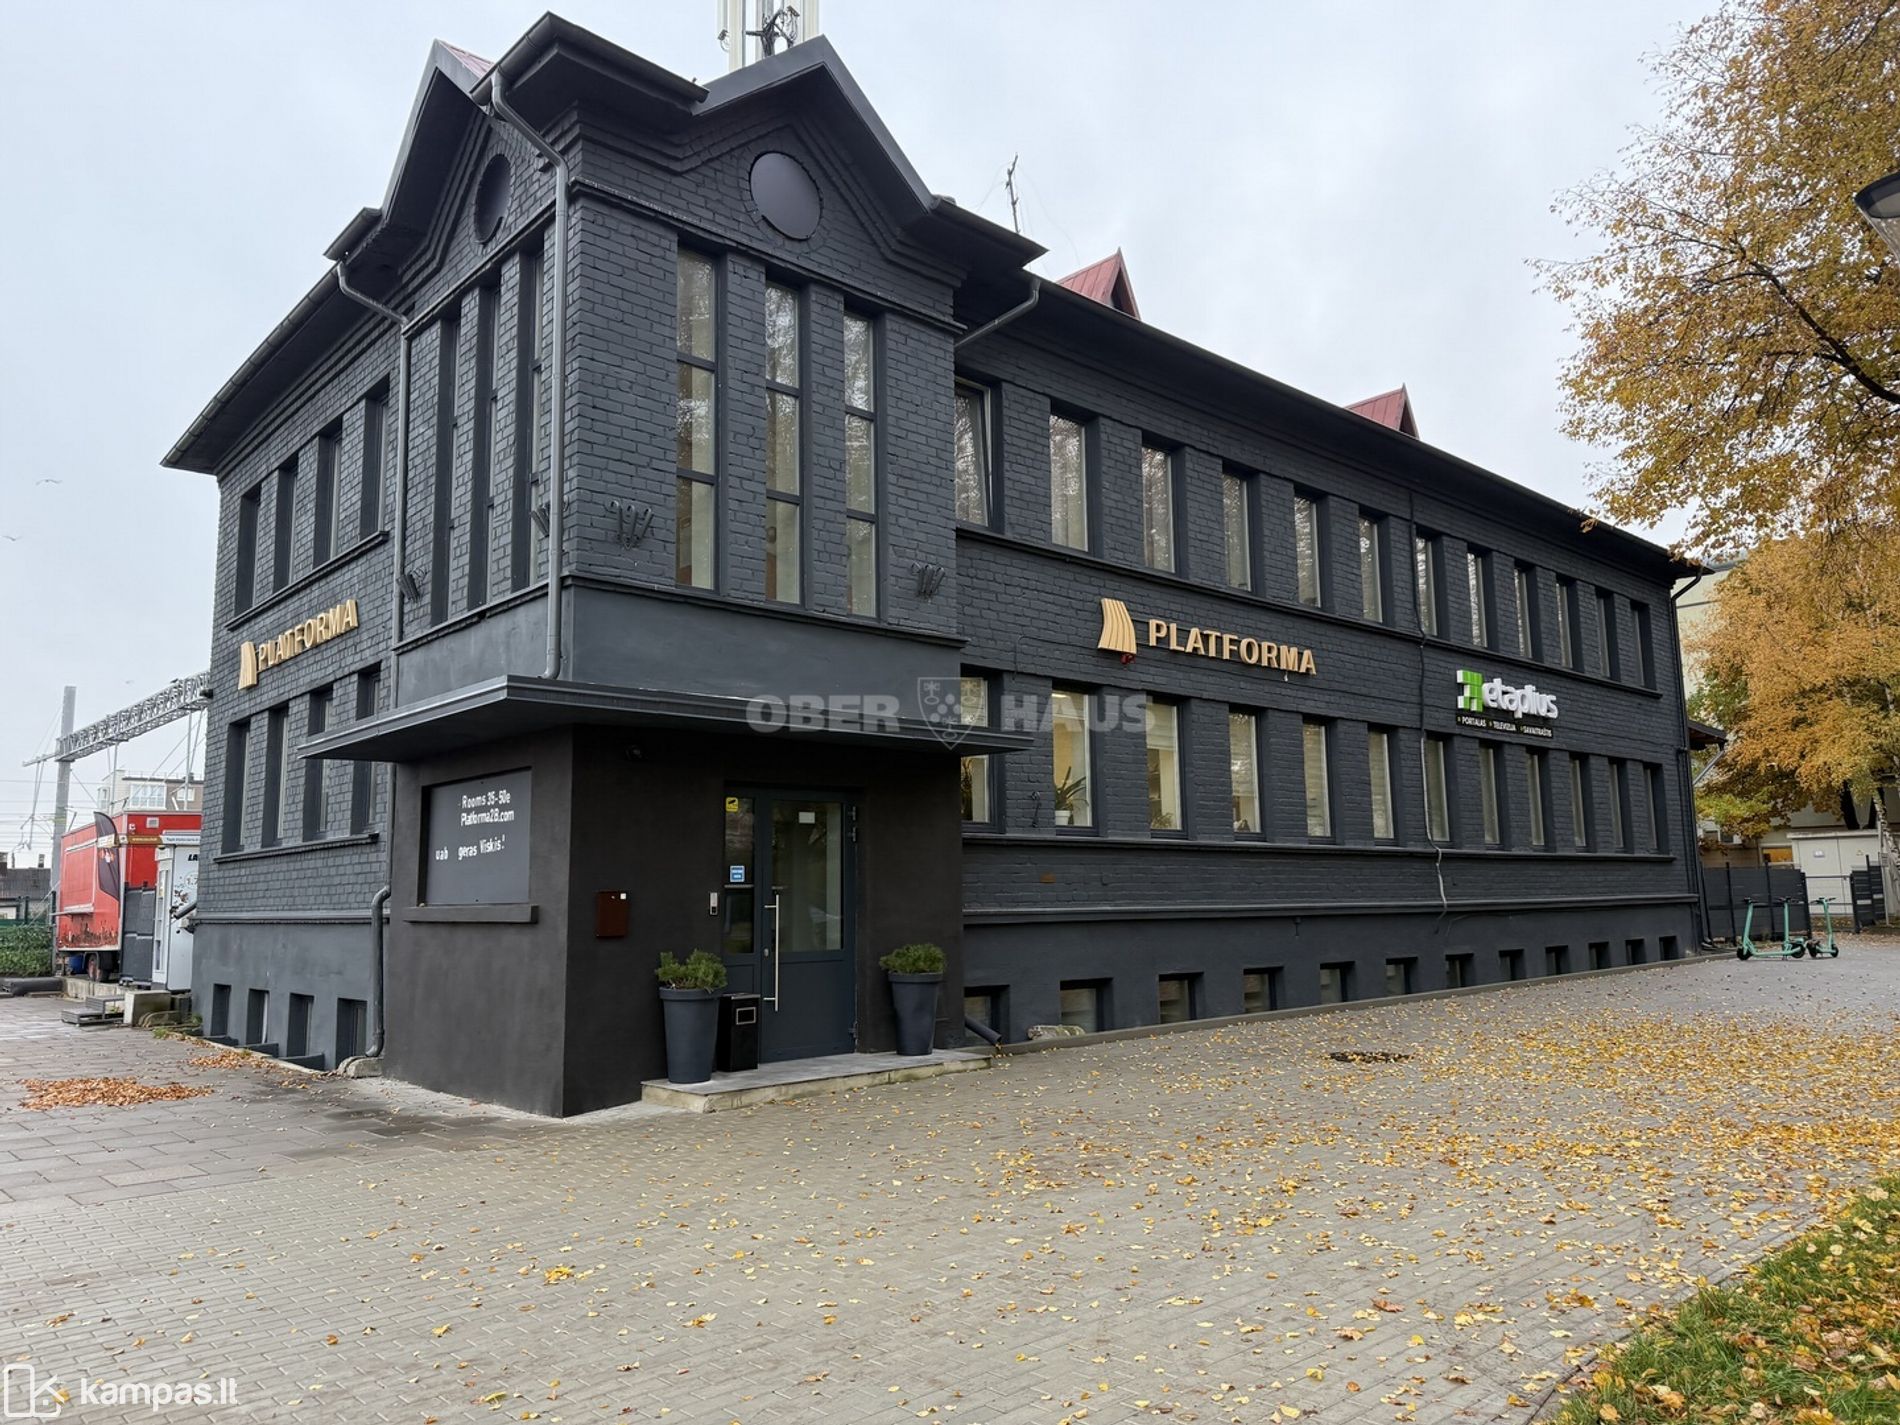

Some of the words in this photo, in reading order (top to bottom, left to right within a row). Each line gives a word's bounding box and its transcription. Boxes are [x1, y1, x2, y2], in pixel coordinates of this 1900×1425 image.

[258, 599, 359, 671] PLATFORMA
[1149, 618, 1317, 675] PLATFORMA
[461, 795, 486, 808] Rooms
[435, 846, 449, 860] uab
[457, 845, 478, 861] geras
